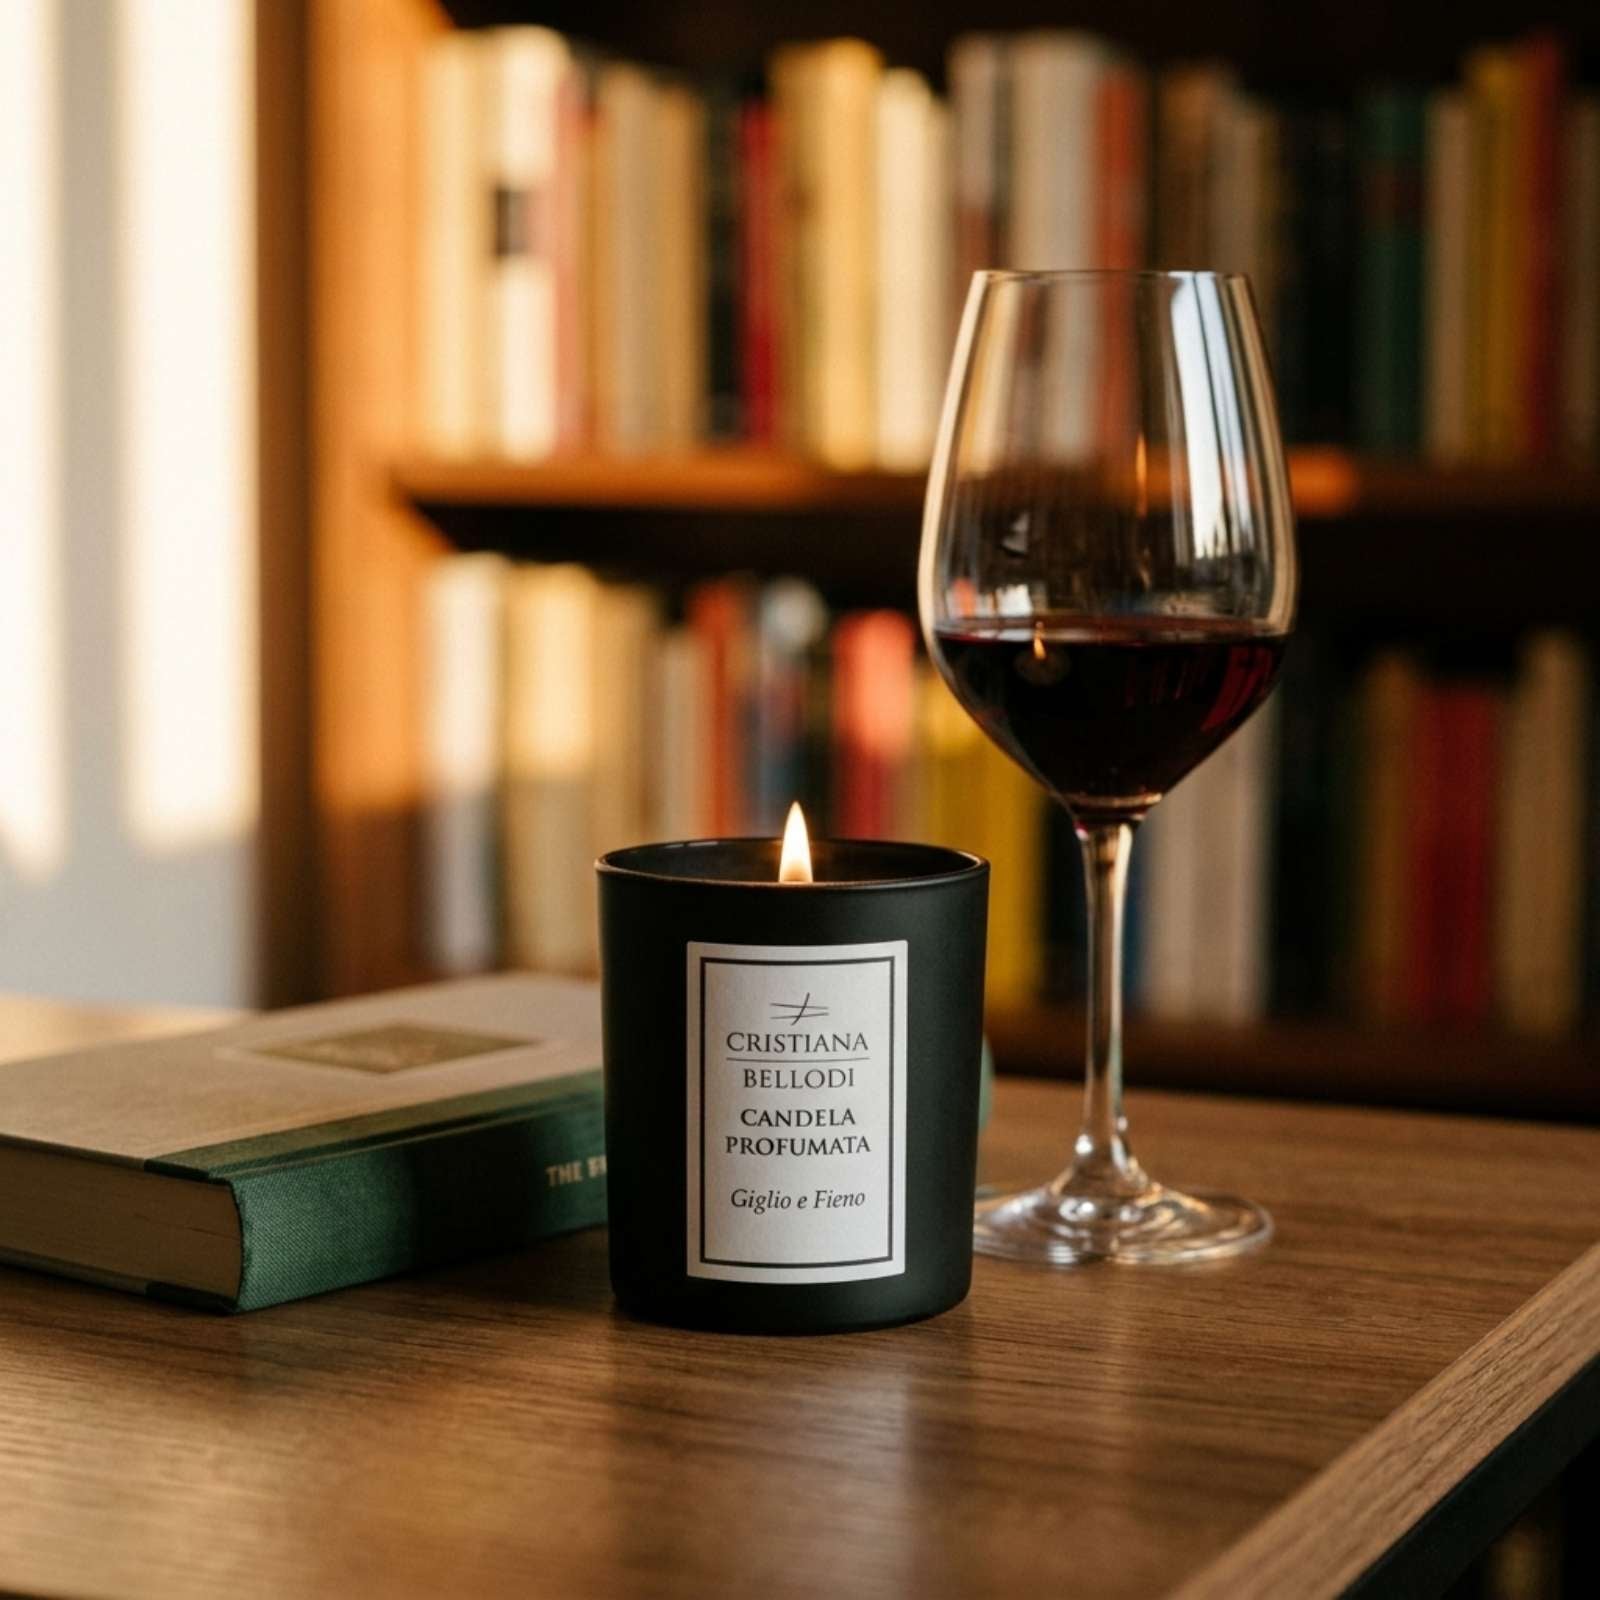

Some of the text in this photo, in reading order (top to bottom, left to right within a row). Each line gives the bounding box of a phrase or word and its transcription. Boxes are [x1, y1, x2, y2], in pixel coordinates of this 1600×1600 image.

[726, 1032, 869, 1053] CRISTIANA
[743, 1068, 854, 1089] BELLODI
[740, 1108, 856, 1128] CANDELA
[725, 1136, 871, 1156] PROFUMATA
[547, 1162, 583, 1186] THE
[730, 1189, 865, 1215] Giglio e Fieno
